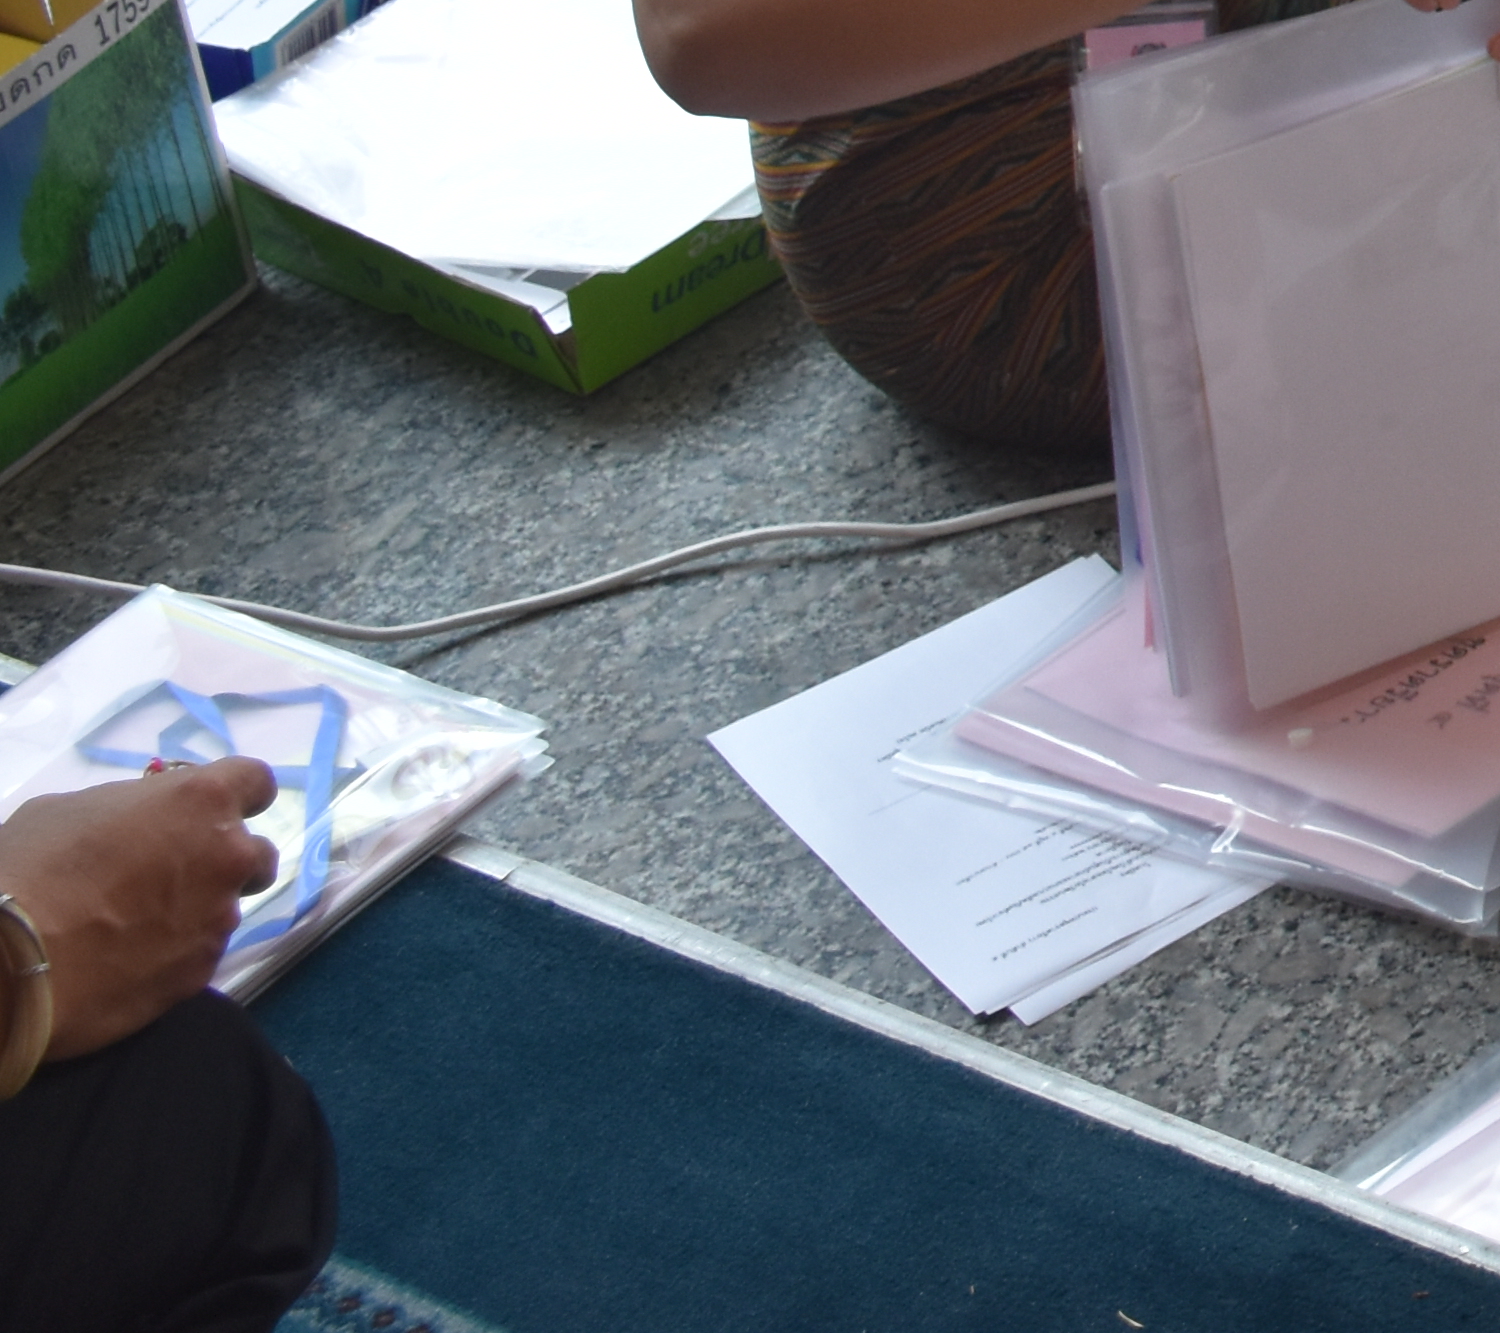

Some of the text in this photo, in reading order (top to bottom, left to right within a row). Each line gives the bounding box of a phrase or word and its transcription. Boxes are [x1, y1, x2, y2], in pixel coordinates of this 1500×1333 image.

[360, 262, 535, 358] Double A
[650, 225, 767, 314] Dream
